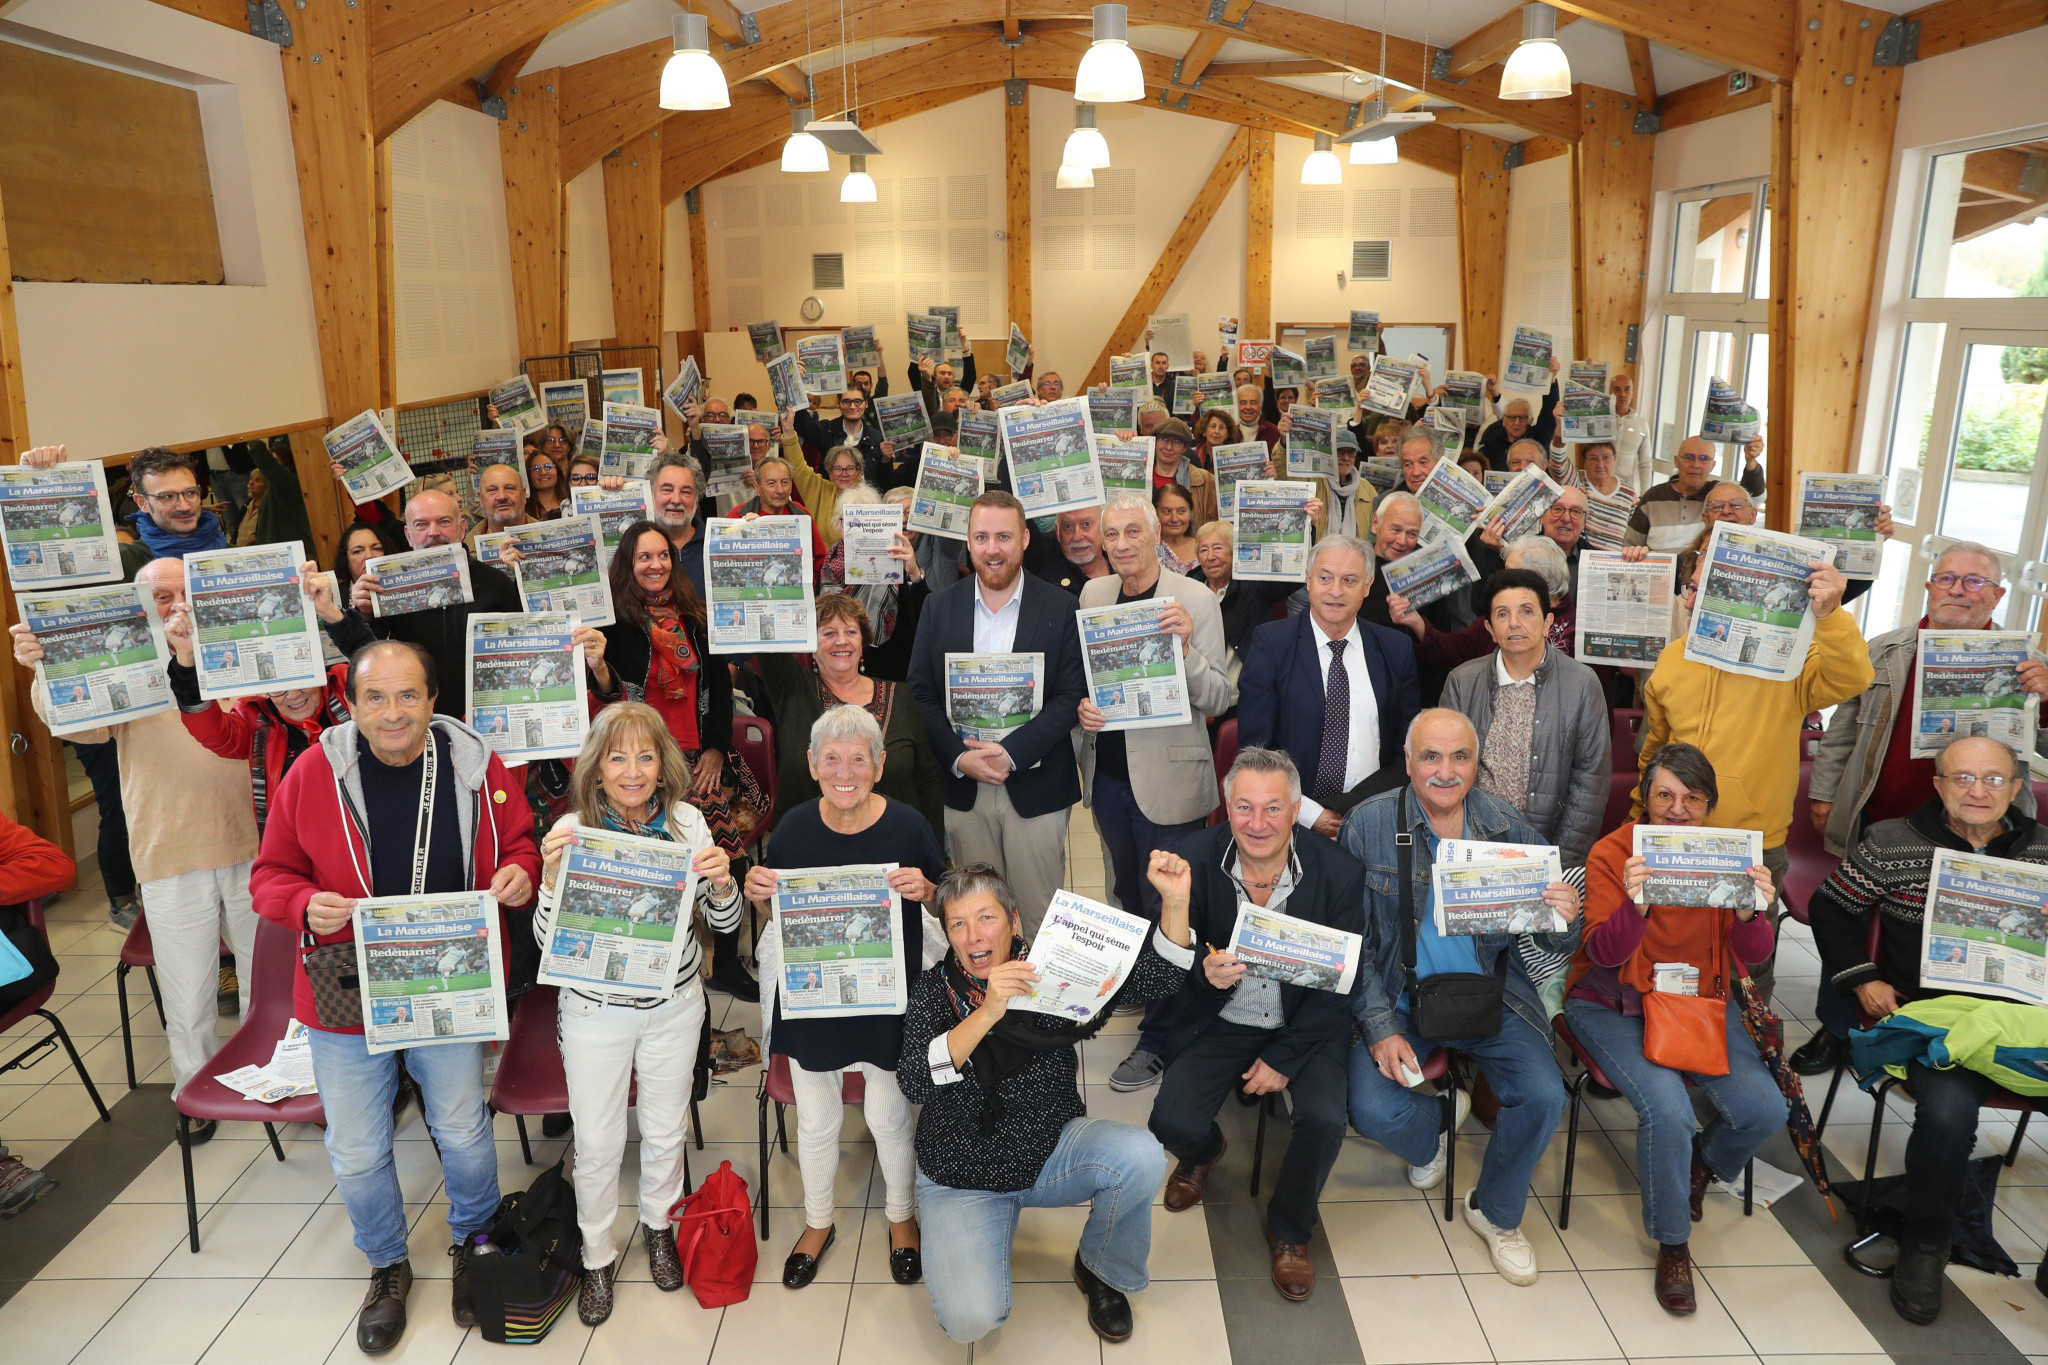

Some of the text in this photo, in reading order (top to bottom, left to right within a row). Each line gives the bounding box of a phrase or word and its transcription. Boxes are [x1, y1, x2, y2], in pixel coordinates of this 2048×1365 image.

[1026, 416, 1074, 430] Marseillaise
[1012, 436, 1054, 448] Redémarrer
[9, 485, 84, 496] La Marseillaise
[1429, 481, 1458, 503] Redémarrer
[1447, 478, 1479, 503] Marseillaise
[1824, 493, 1873, 501] Marseillaise
[4, 504, 58, 512] Redémarrer
[594, 501, 637, 510] Marseillaise
[1805, 506, 1846, 514] Redémarrer
[534, 537, 585, 550] Marseillaise
[719, 541, 790, 550] La Marseillaise
[713, 560, 764, 568] Redémarrer
[1726, 551, 1806, 575] La Marseillaise
[383, 568, 448, 585] La Marseillaise
[1407, 560, 1449, 584] Marseillaise
[1712, 568, 1770, 587] Redémarrer
[202, 572, 284, 587] La Marseillaise
[196, 595, 256, 607] Redémarrer
[380, 588, 427, 602] Redémarrer
[42, 609, 131, 627] La Marseillaise
[38, 628, 102, 645] Redémarrer
[1095, 623, 1160, 639] La Marseillaise
[485, 638, 559, 649] La Marseillaise
[1091, 643, 1137, 656] Redémarrer
[476, 660, 530, 669] Redémarrer
[1936, 654, 2019, 662] La Marseillaise
[971, 675, 1024, 683] Marseillaise
[423, 757, 433, 813] JEAN-LOUIS
[1656, 855, 1741, 867] La Marseillaise
[583, 858, 597, 869] La
[599, 860, 672, 882] Marseillaise
[568, 879, 634, 897] Redémarrer
[1646, 876, 1709, 886] Redémarrer
[1455, 886, 1537, 900] La Marseillaise
[1950, 878, 2040, 902] La Marseillaise
[792, 892, 876, 905] La Marseillaise
[1938, 895, 2002, 913] Redémarrer
[784, 914, 845, 925] Redémarrer
[1055, 896, 1143, 936] La Marseillaise
[1448, 910, 1507, 920] Redémarrer
[378, 923, 472, 936] La Marseillaise
[1053, 915, 1088, 934] L'appel
[1089, 928, 1105, 941] qui
[1072, 932, 1106, 951] l'espoir
[1250, 935, 1332, 961] La Marseillaise
[370, 948, 437, 958] Redémarrer
[1237, 952, 1296, 973] Redémarrer
